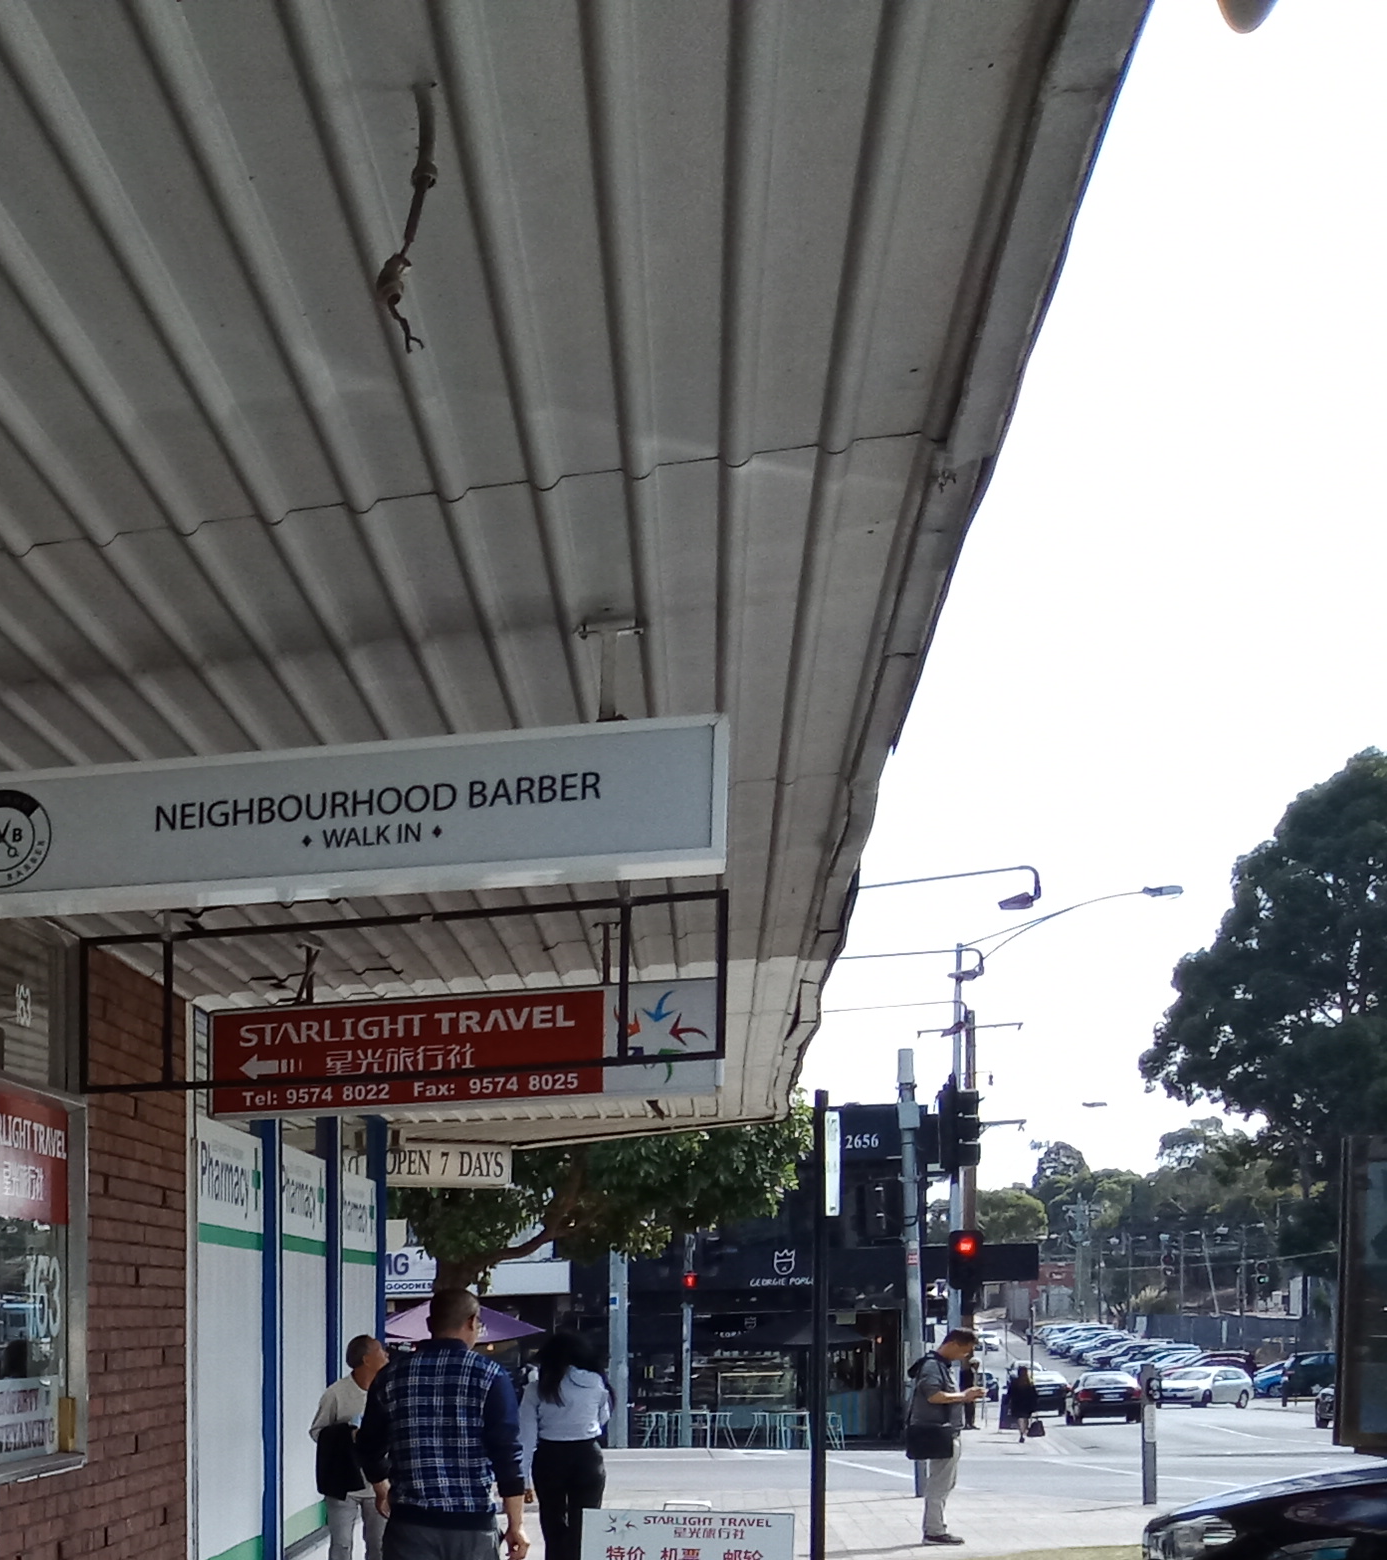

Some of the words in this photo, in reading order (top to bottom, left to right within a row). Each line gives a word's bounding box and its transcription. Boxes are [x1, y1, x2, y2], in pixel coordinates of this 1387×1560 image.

[153, 781, 458, 832] NEIGHBOURHOOD
[467, 771, 602, 809] BARBER
[322, 825, 390, 849] WALK
[397, 822, 422, 845] IN
[239, 1013, 427, 1048] STARLIGHT
[434, 1005, 576, 1035] TRAVEL
[325, 1042, 476, 1076] 星光旅行社
[242, 1090, 278, 1106] Tel:
[286, 1086, 333, 1105] 9574
[342, 1083, 390, 1102] 8022
[413, 1081, 455, 1098] Fax:
[469, 1076, 518, 1095] 9574
[528, 1072, 579, 1091] 8025
[33, 1121, 67, 1160] TRAVEL
[845, 1133, 879, 1149] 2656
[200, 1141, 250, 1219] Pharmacy
[385, 1149, 432, 1175] OPEN
[440, 1151, 451, 1176] 7
[458, 1152, 505, 1178] DAYS
[643, 1515, 713, 1526] STARLIGHT
[720, 1517, 772, 1528] TRAVEL
[673, 1527, 746, 1540] 星光旅行社
